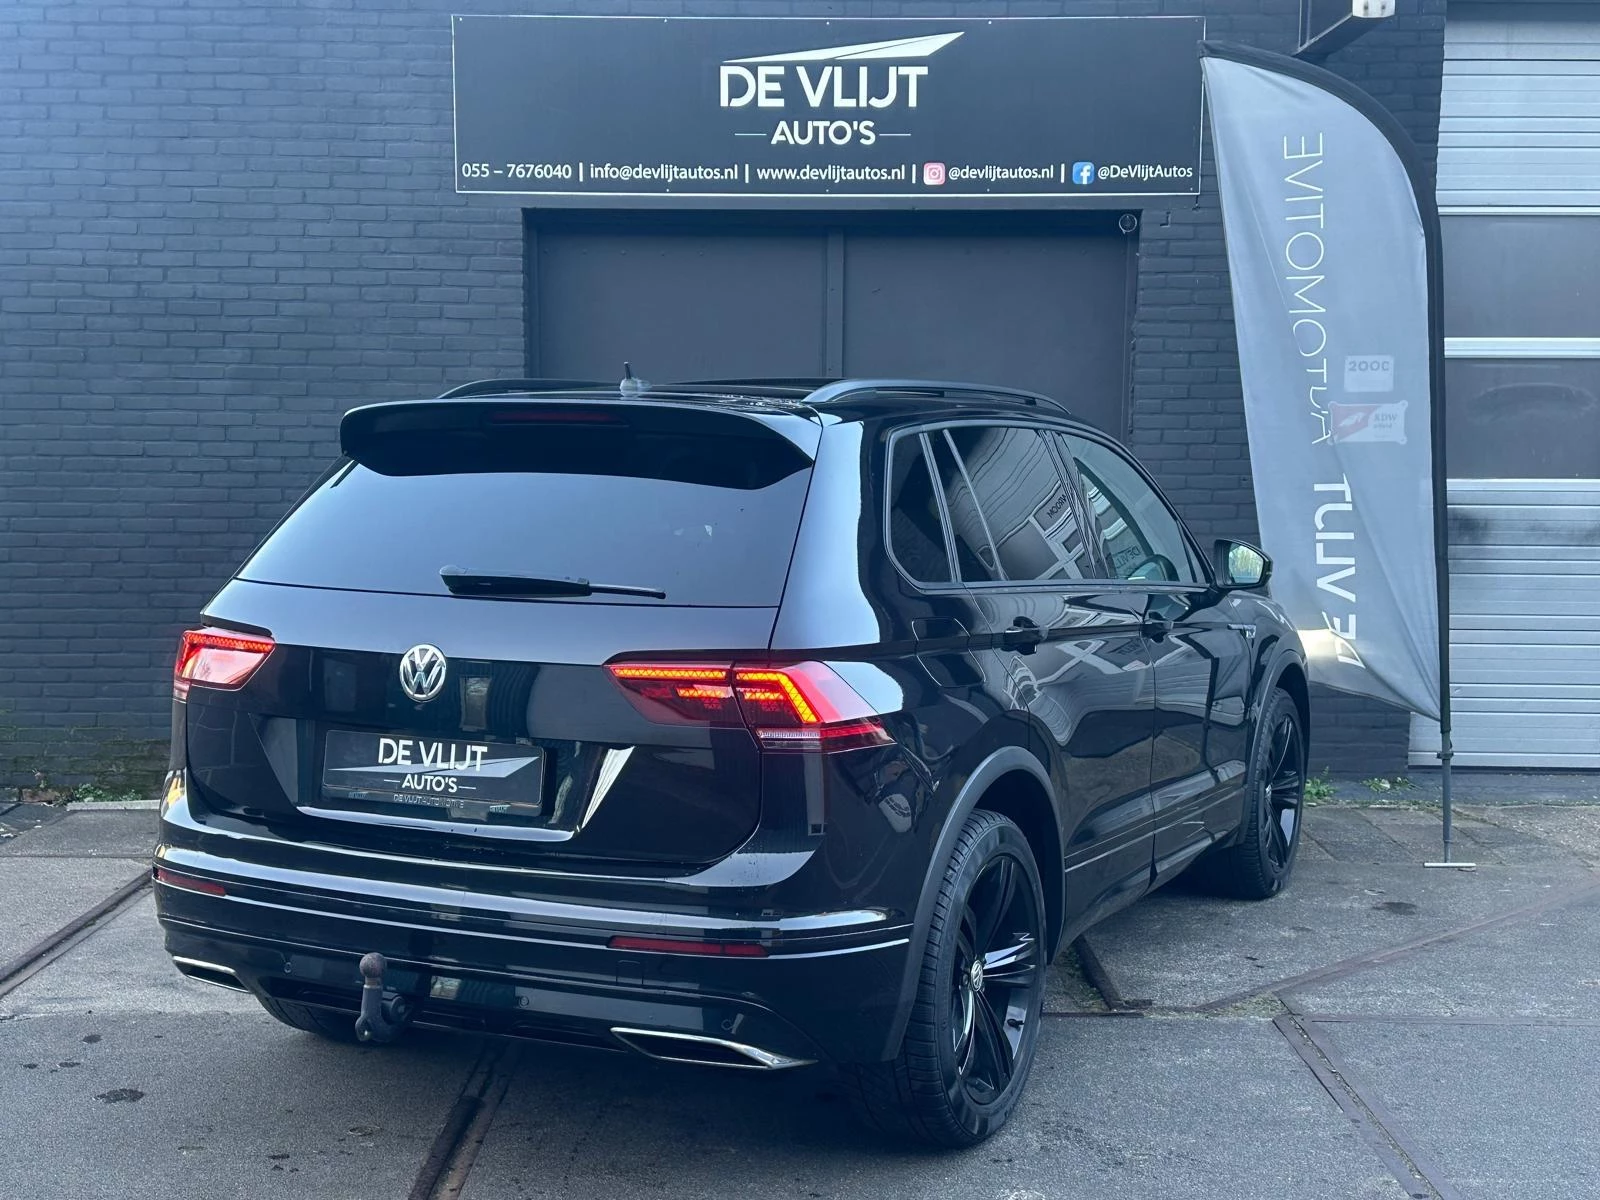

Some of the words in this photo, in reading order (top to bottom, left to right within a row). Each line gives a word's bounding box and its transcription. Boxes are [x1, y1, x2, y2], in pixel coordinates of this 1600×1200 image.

[720, 65, 785, 108] DE
[796, 65, 929, 109] VLIJT
[771, 120, 876, 146] AUTO'S
[462, 163, 490, 178] 055
[507, 163, 572, 179] 7676040
[591, 163, 738, 183] info@devlijtautos.nl
[757, 164, 905, 182] www.devlijtautos.nl
[948, 164, 1054, 182] @devlijtautos.nl
[1097, 164, 1193, 181] @DeVlijtAutos
[378, 737, 414, 765] DE
[419, 741, 488, 772] VLIJT
[401, 773, 458, 793] AUTO'S
